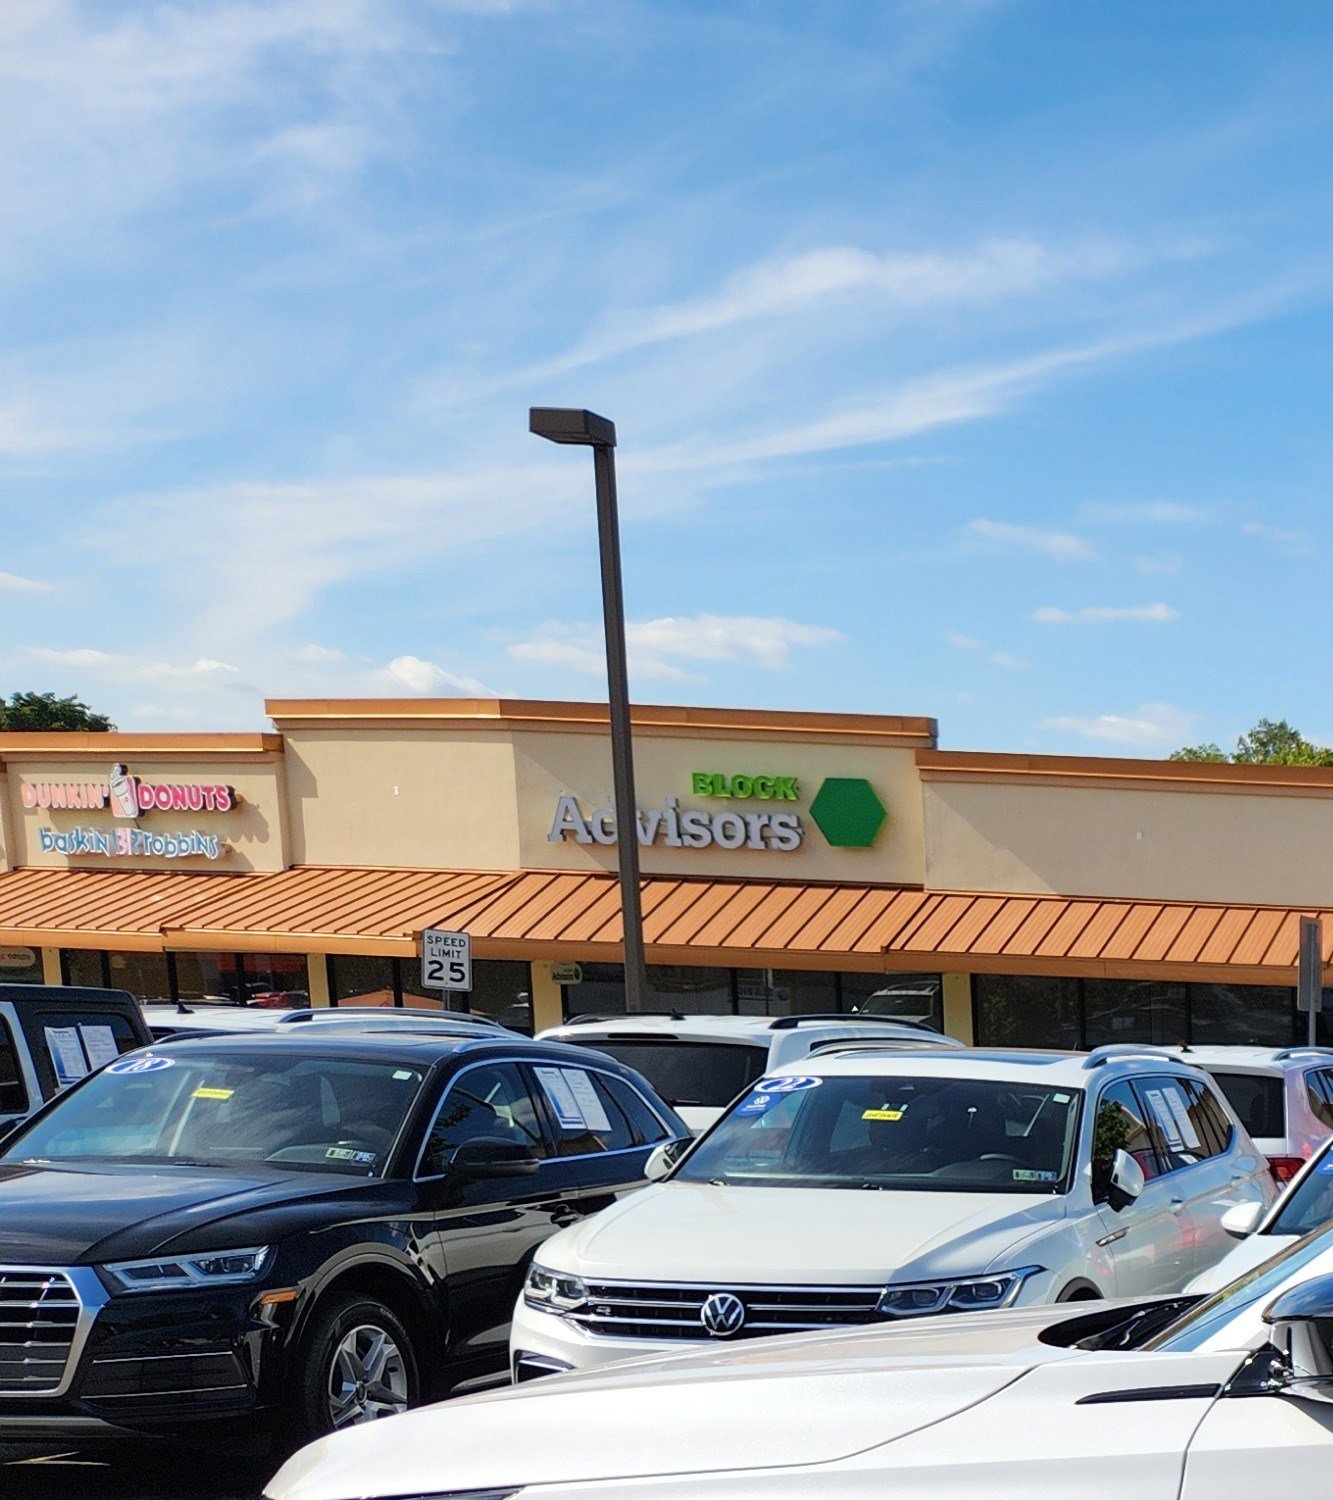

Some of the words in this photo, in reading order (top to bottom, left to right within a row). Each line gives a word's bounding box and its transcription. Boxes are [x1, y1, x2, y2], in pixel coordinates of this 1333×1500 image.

[20, 783, 109, 809] DUNKIN'
[138, 783, 232, 811] DONUTS
[692, 772, 798, 800] BLOCK
[427, 935, 466, 948] SPEED
[431, 948, 462, 959] LIMIT
[427, 960, 466, 983] 25
